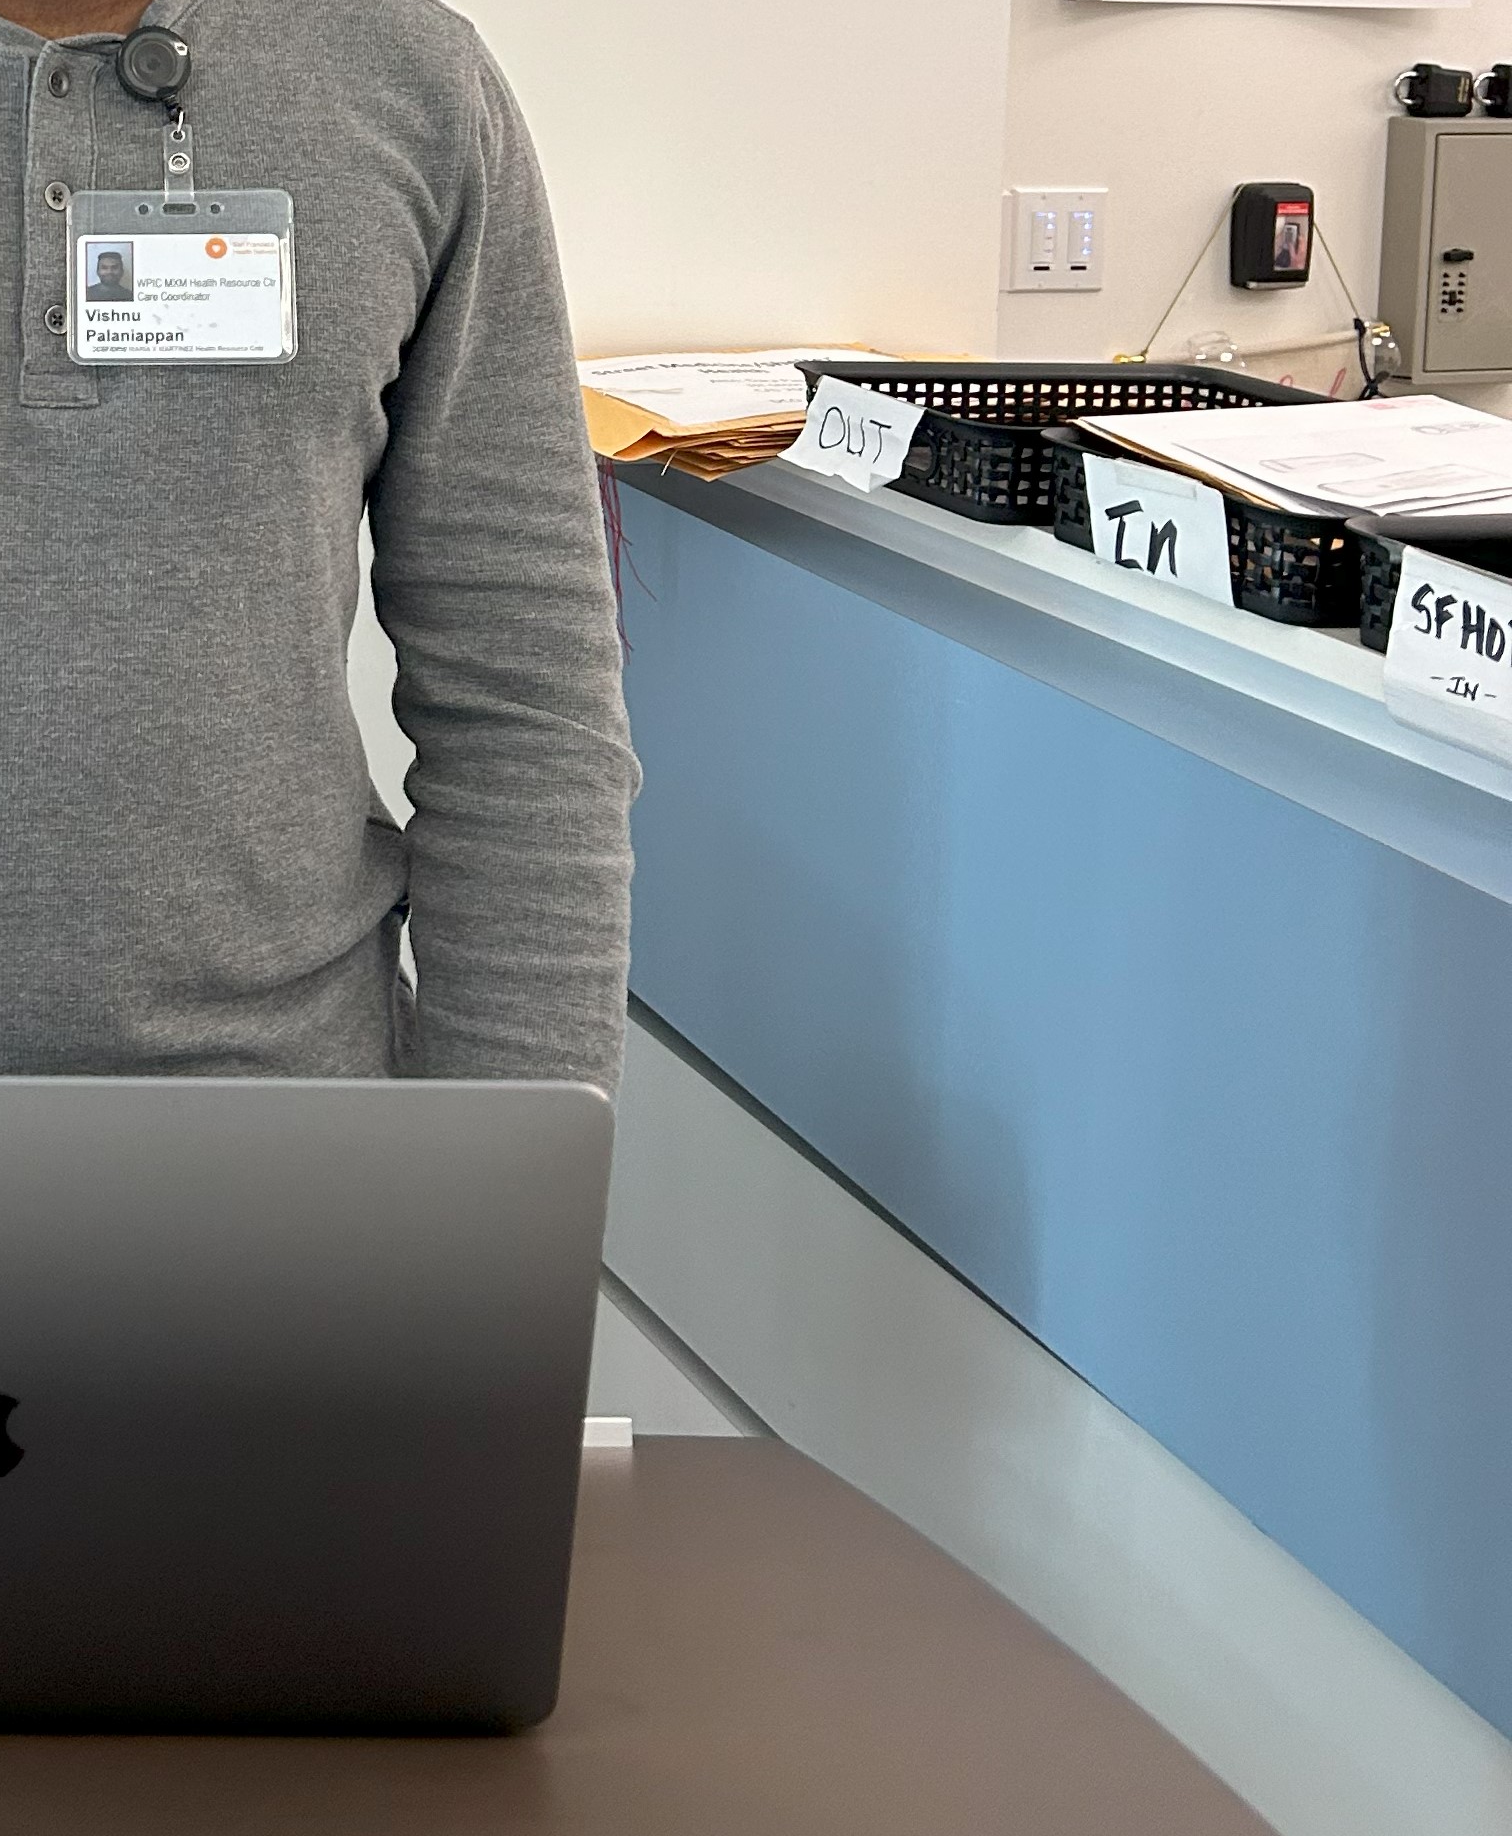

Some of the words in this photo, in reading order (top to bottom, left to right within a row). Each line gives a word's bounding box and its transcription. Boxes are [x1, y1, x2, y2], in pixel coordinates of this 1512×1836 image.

[189, 278, 217, 288] Health
[219, 277, 261, 288] Resource
[137, 292, 158, 302] Care
[160, 291, 211, 302] Coordinator
[85, 309, 141, 322] Vishnu
[86, 329, 184, 345] Palaniappan
[818, 406, 892, 464] OUT
[1104, 499, 1178, 578] In
